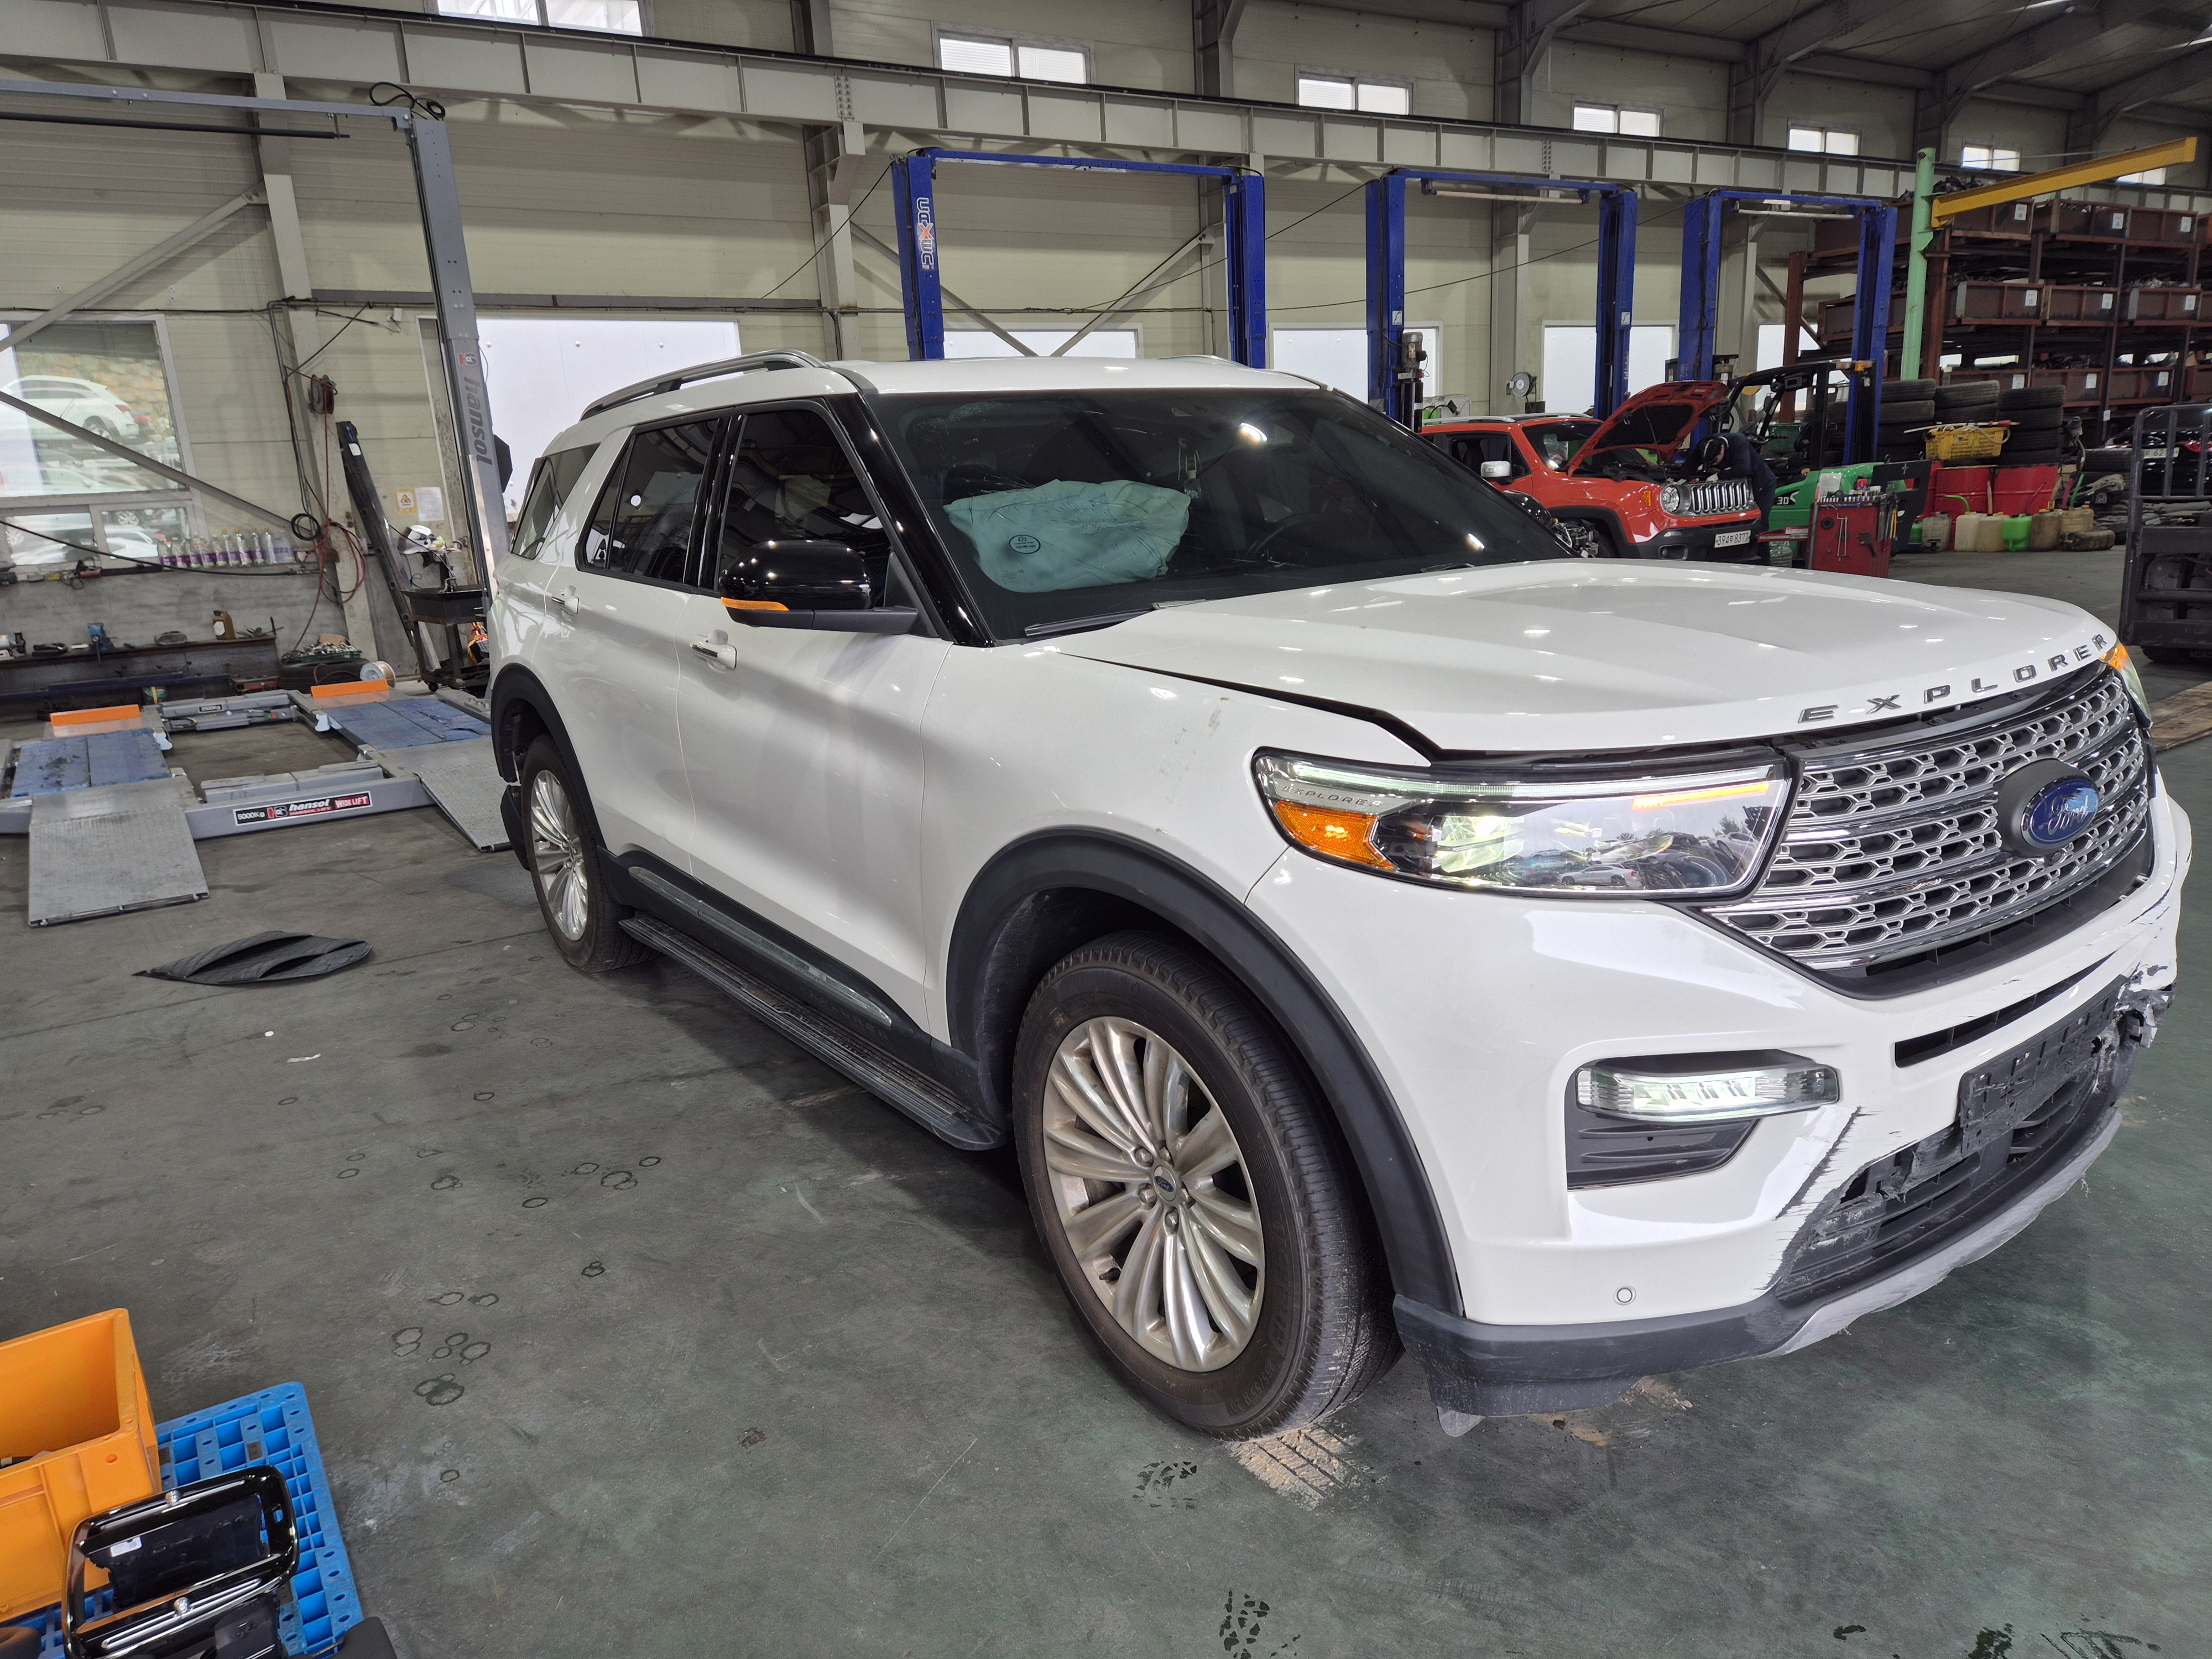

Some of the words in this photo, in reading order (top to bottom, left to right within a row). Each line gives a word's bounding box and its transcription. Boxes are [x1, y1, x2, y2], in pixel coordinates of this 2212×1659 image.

[463, 376, 493, 466] hansol
[1777, 497, 1790, 505] 30
[1734, 532, 1749, 544] 8377
[1798, 633, 2107, 723] EXPLORER
[334, 799, 352, 809] WIDE
[351, 796, 368, 806] LIFT
[1282, 786, 1383, 807] EXPLORER
[289, 799, 330, 812] hansol
[2047, 795, 2089, 835] Ford
[1157, 1178, 1170, 1190] Ford
